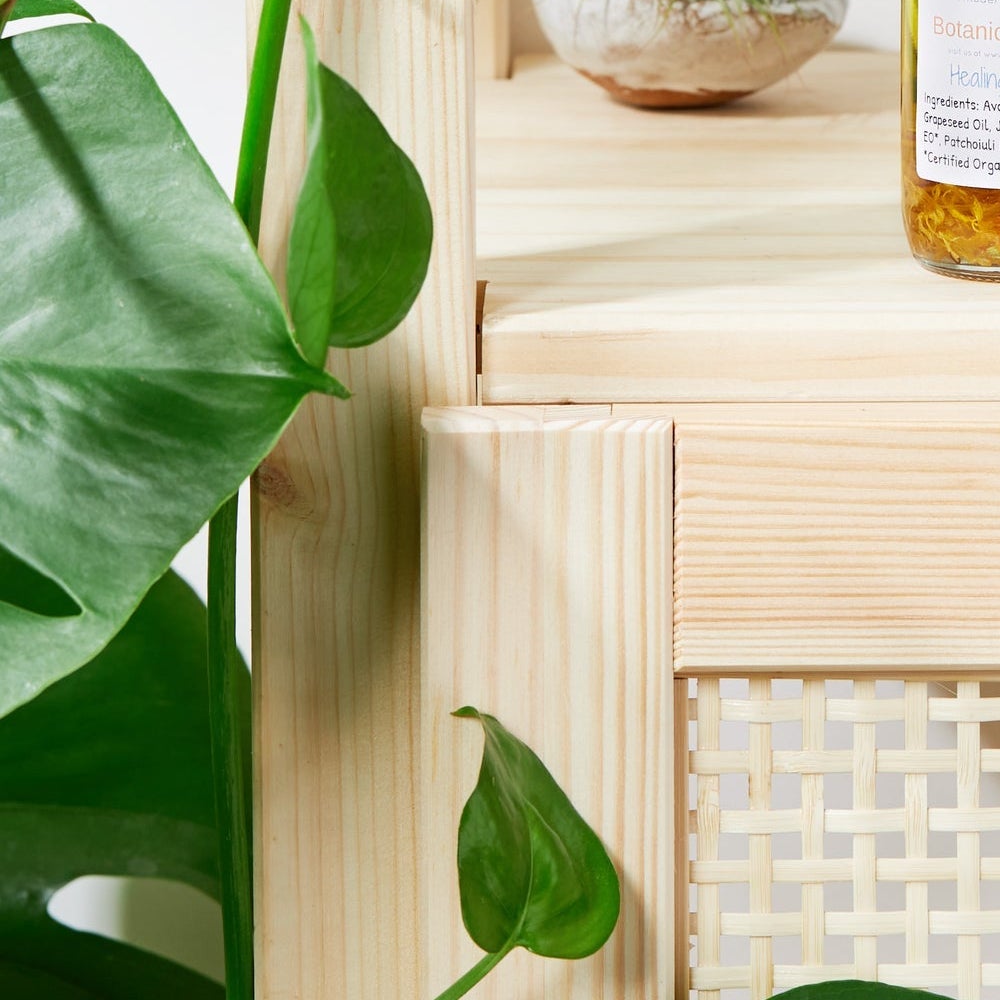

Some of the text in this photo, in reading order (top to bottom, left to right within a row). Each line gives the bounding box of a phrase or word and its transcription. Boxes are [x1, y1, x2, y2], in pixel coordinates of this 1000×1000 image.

[924, 92, 979, 110] Ingredients:
[923, 111, 970, 129] Grapeseed
[972, 118, 991, 133] Oil,
